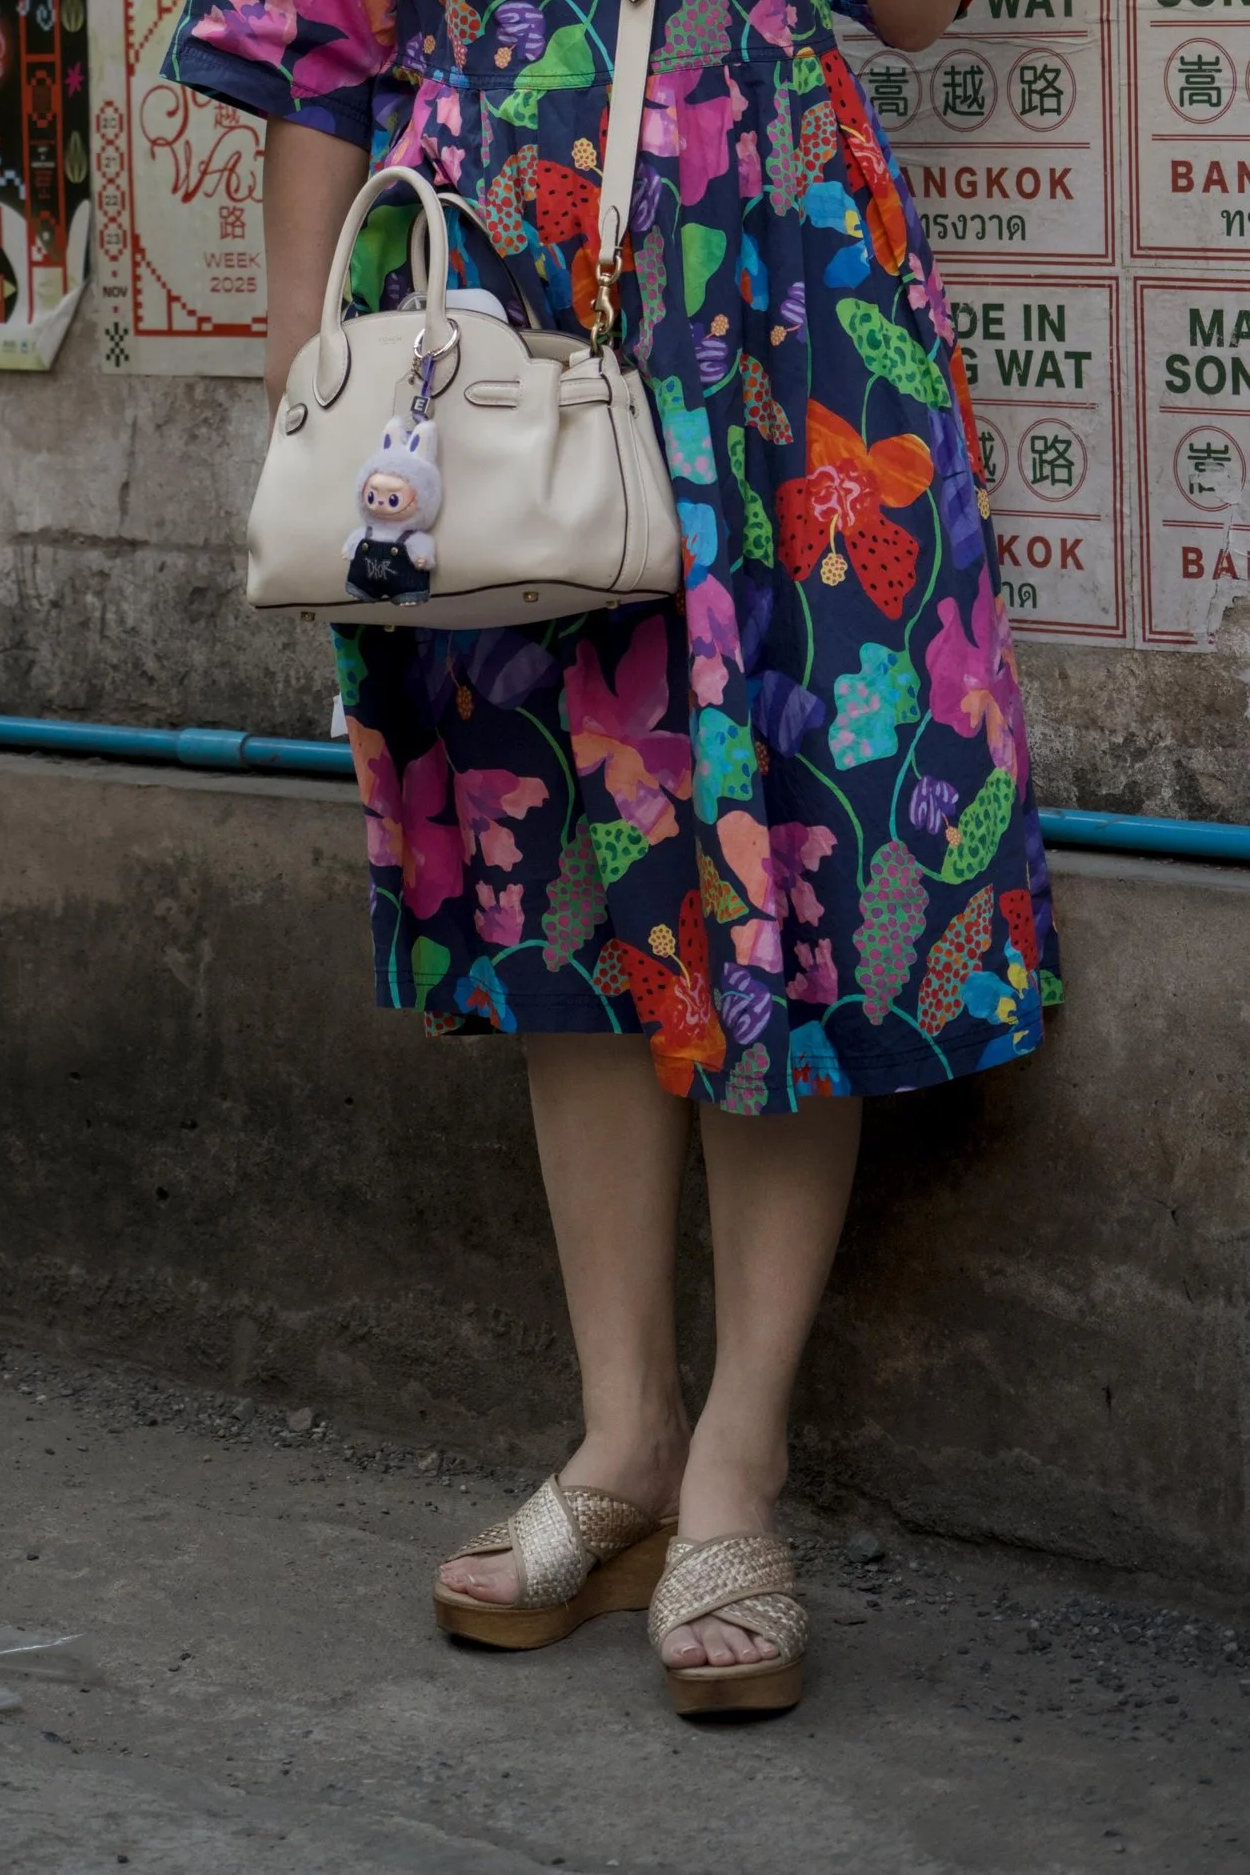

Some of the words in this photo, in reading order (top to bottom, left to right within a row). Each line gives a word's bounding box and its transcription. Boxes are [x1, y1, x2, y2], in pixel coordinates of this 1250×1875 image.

[204, 251, 261, 269] WEEK
[102, 286, 128, 298] NOV
[209, 277, 258, 293] 2025
[951, 302, 1005, 341] DE
[1023, 304, 1066, 343] IN
[994, 348, 1092, 390] WAT
[414, 398, 426, 411] E
